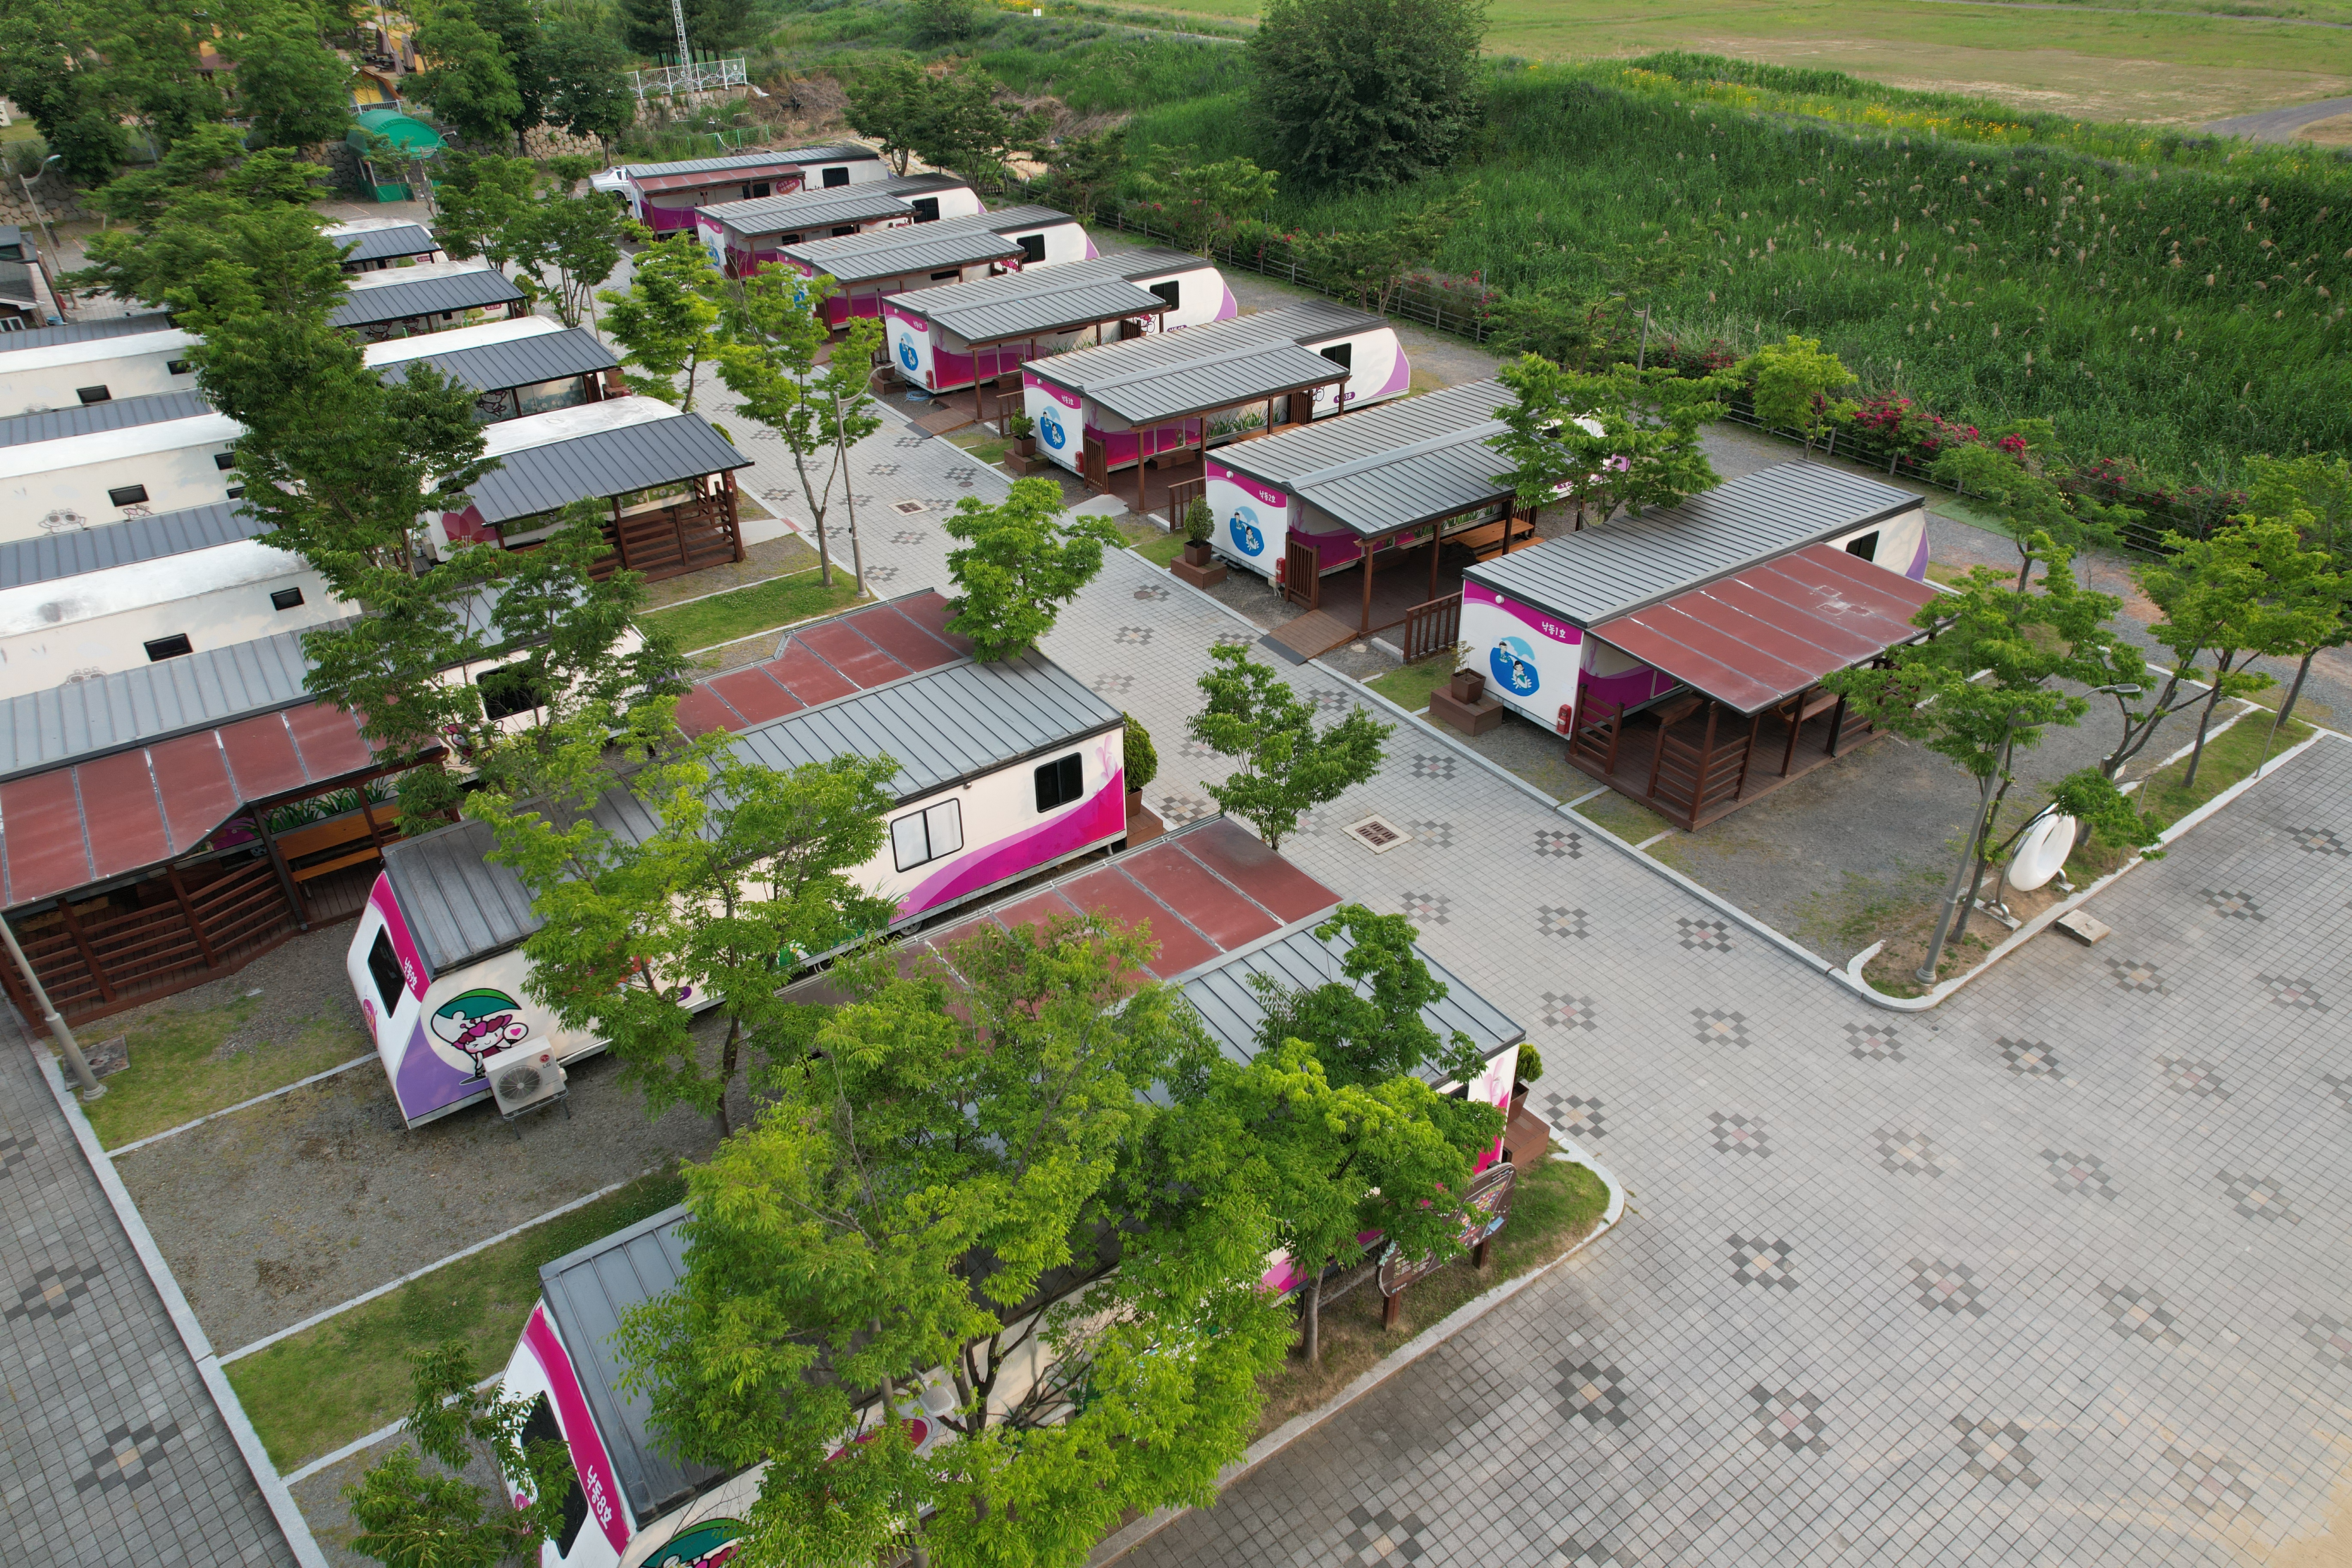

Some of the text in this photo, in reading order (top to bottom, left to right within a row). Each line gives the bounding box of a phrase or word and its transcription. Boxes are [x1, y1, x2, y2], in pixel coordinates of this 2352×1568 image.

[1062, 395, 1074, 405] 낙동3호
[1259, 490, 1276, 503] 낙동2호
[1542, 621, 1566, 638] 낙동1호
[404, 957, 417, 990] 낙동9호
[587, 1465, 612, 1530] 낙동8호
